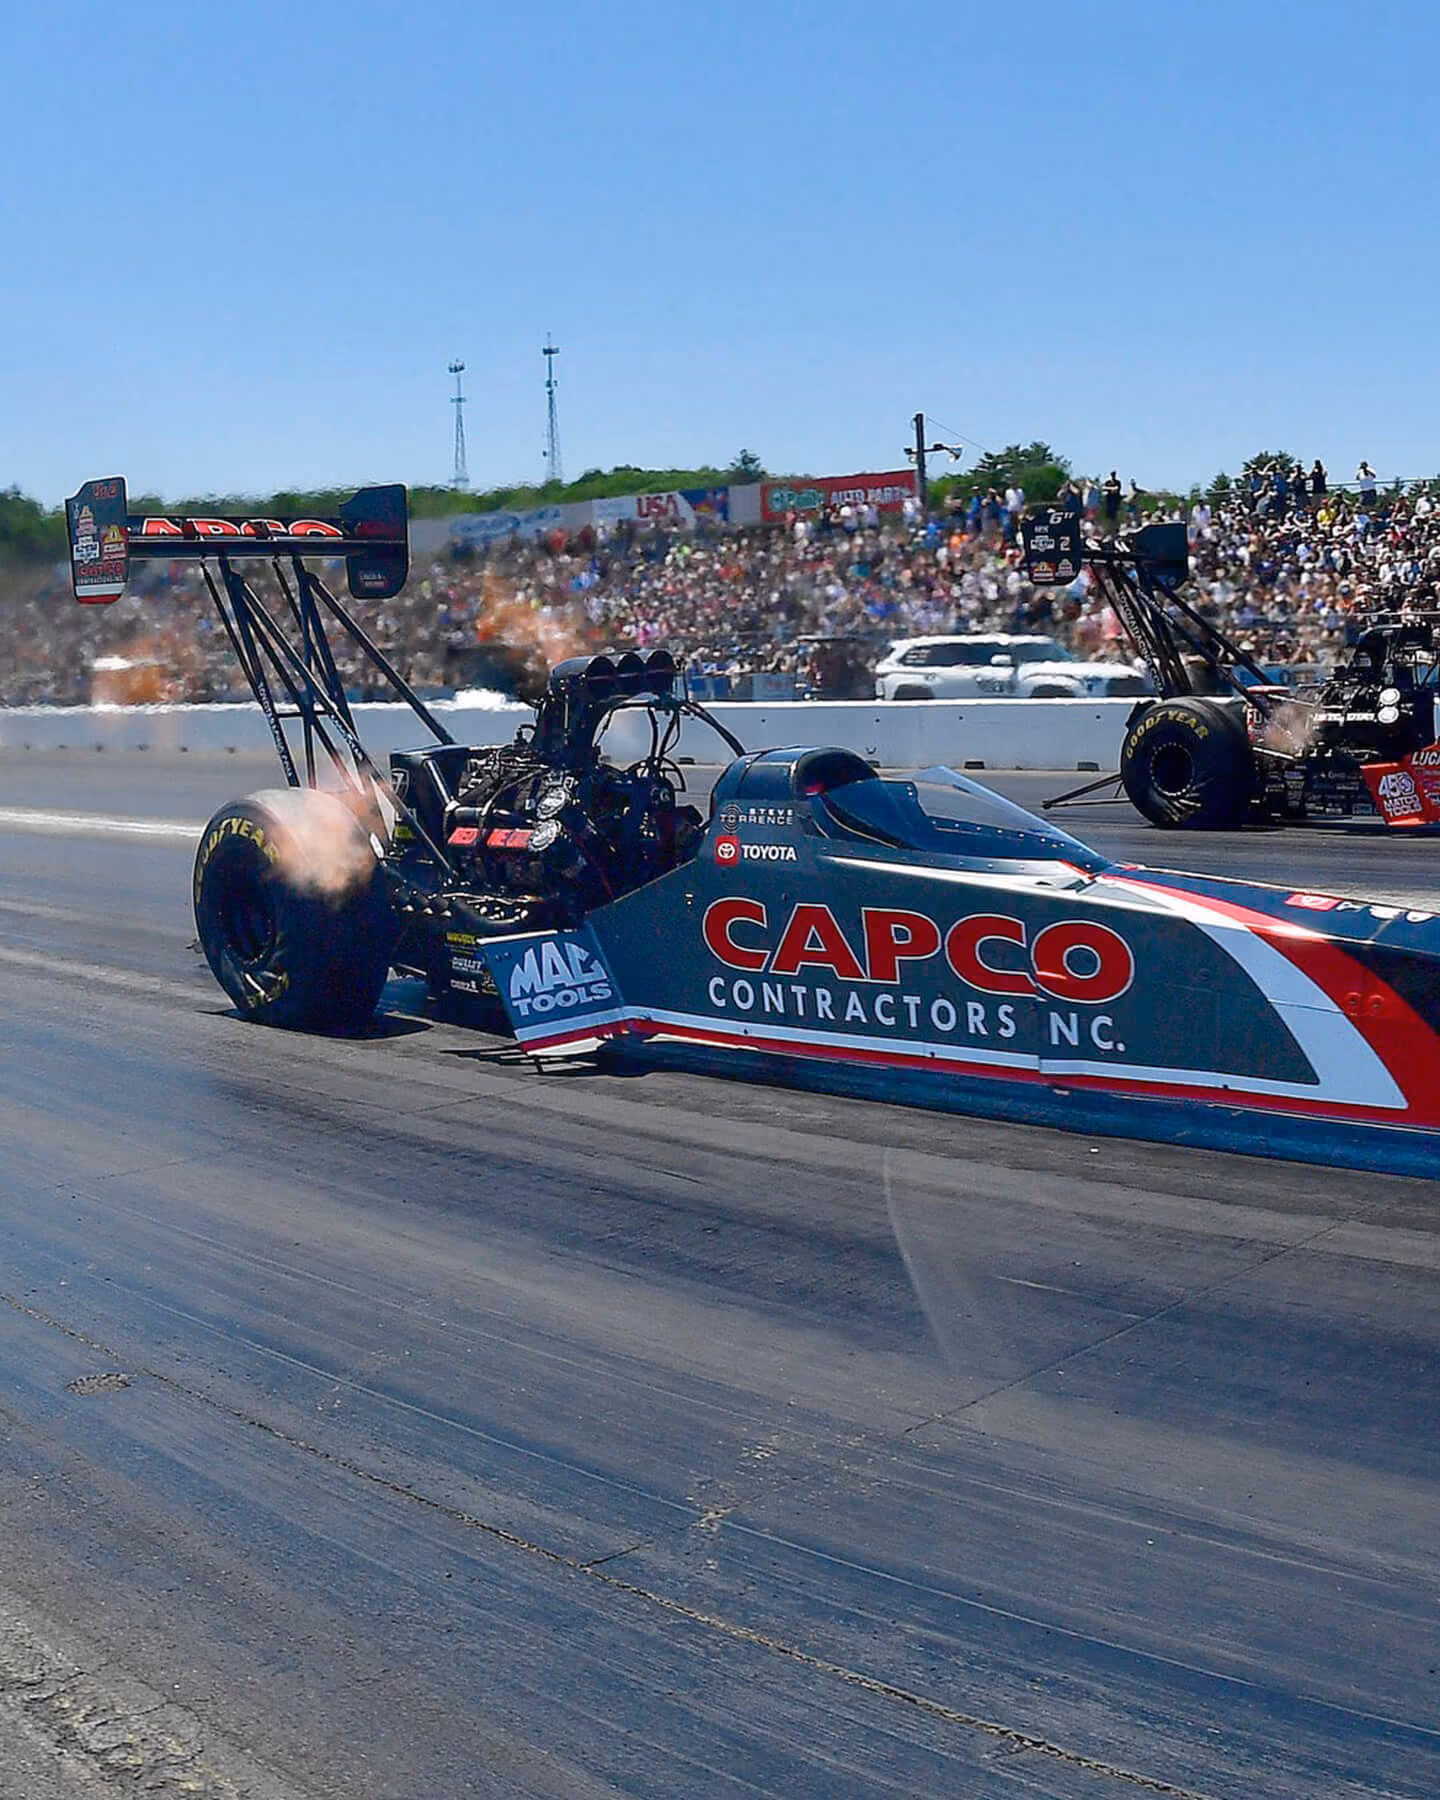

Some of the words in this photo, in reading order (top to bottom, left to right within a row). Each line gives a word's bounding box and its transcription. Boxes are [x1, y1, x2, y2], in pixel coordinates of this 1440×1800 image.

[636, 494, 680, 518] USA
[1126, 709, 1209, 759] GOODYEAR
[720, 814, 793, 825] TORRENCE
[749, 808, 793, 816] STEVE
[741, 842, 798, 861] TOYOTA
[703, 896, 1135, 1004] CAPCO
[510, 941, 608, 998] MAC
[511, 983, 612, 1016] TOOLS
[708, 976, 1017, 1039] CONTRACTORS
